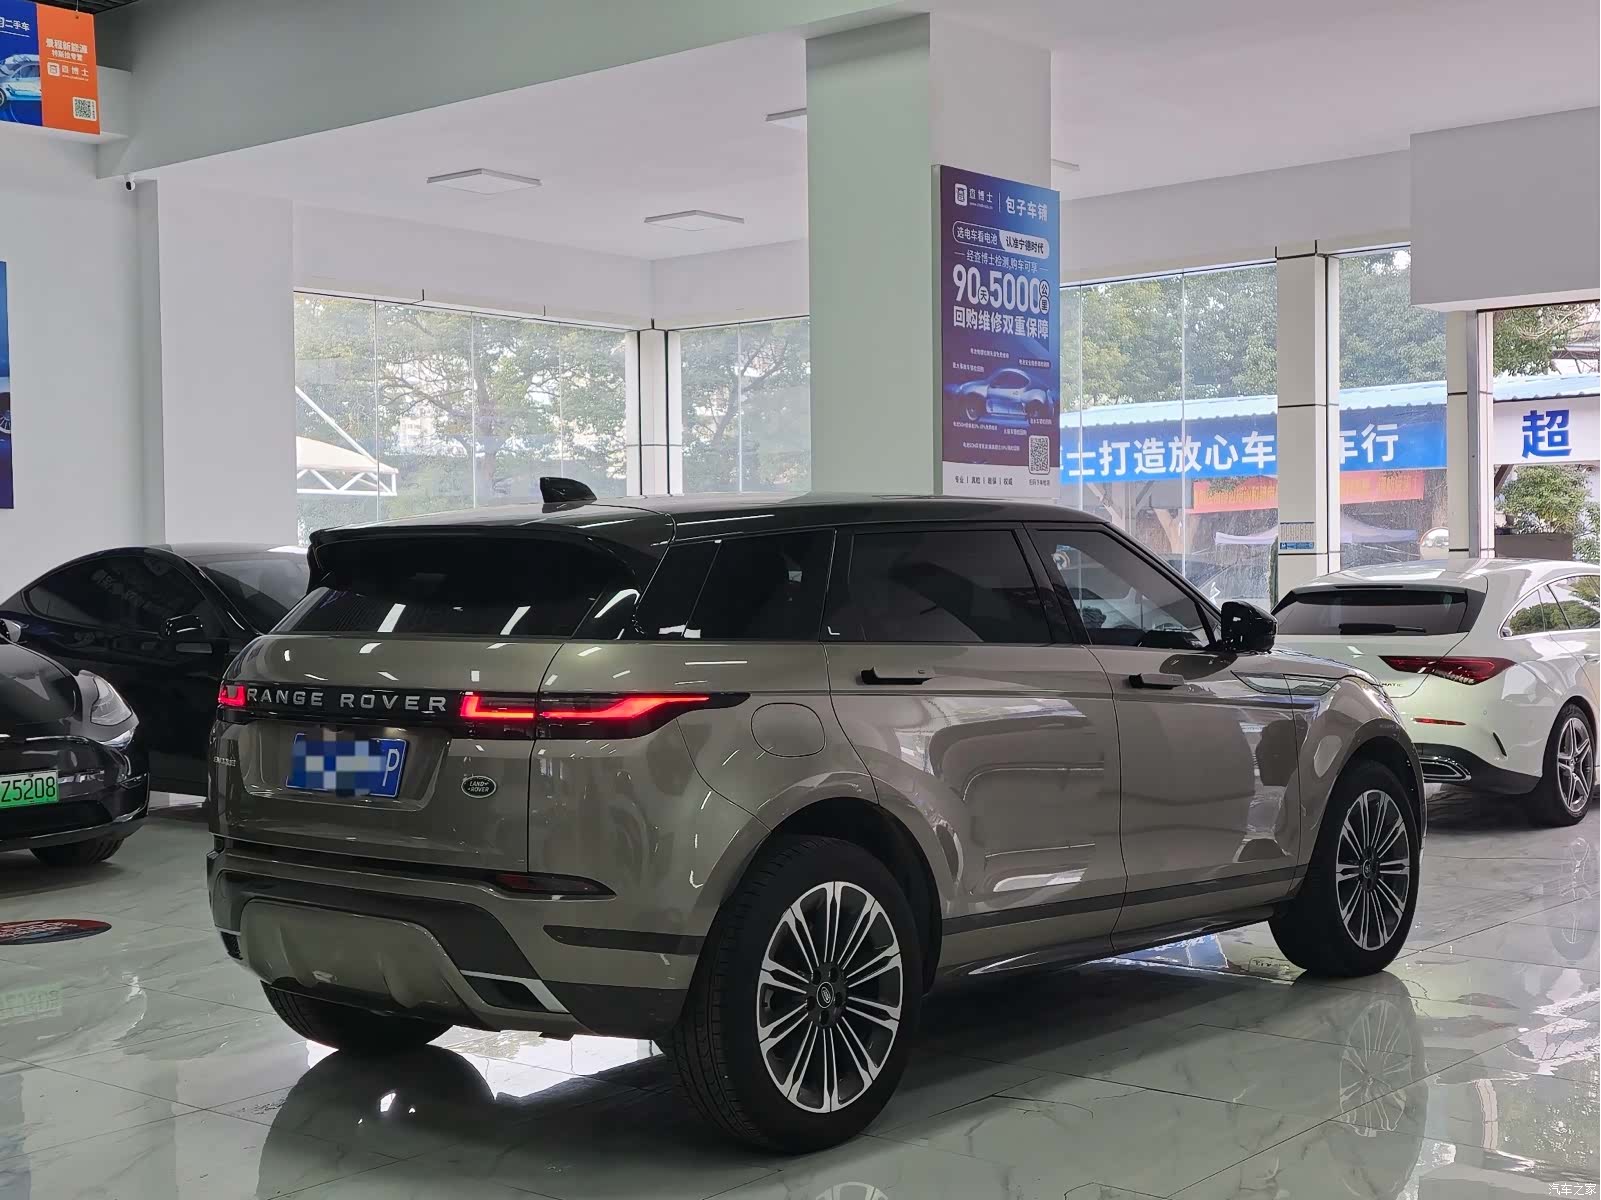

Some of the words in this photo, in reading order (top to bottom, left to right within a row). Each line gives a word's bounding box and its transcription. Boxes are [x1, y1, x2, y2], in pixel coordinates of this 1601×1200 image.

[1005, 196, 1048, 222] 包子车铺
[956, 226, 998, 245] 选电车看电池
[1005, 236, 1044, 254] 认准宁德时代
[953, 305, 1049, 339] 回购维修双重保障
[1522, 409, 1572, 459] 超
[1060, 430, 1276, 478] 士打造放心车
[247, 688, 324, 707] RANGE
[339, 693, 447, 712] ROVER
[1, 776, 56, 802] Z5208
